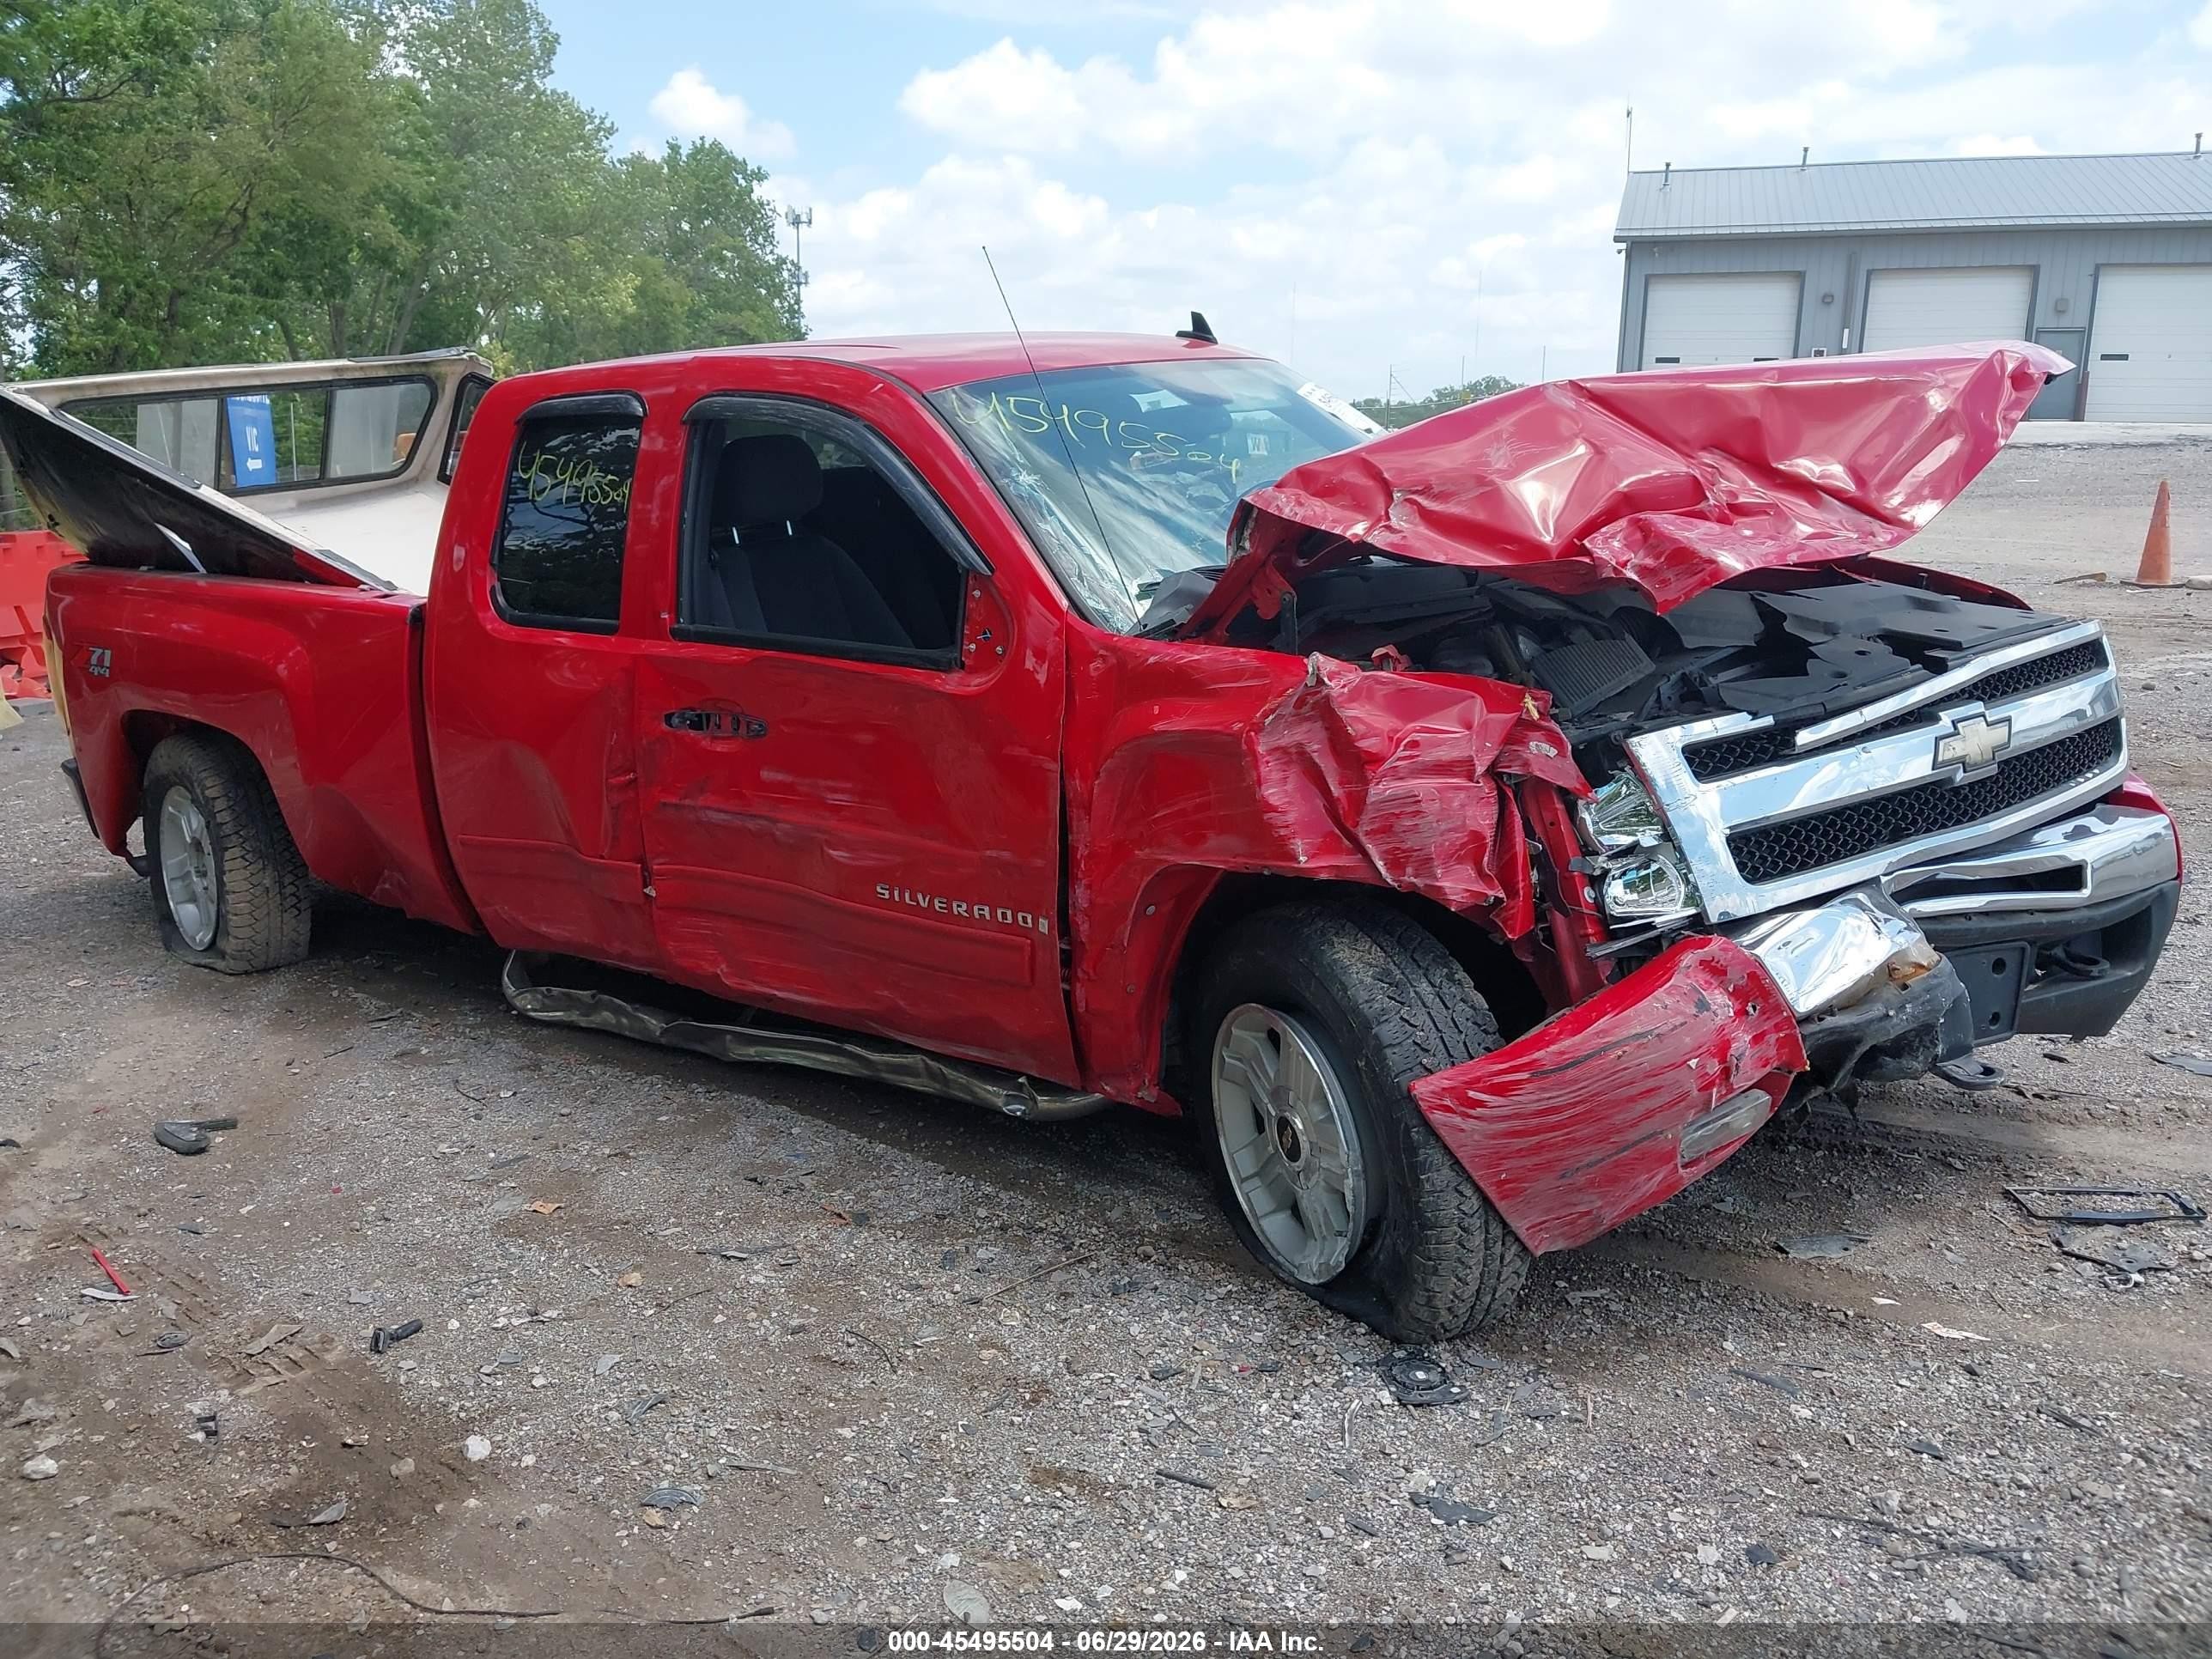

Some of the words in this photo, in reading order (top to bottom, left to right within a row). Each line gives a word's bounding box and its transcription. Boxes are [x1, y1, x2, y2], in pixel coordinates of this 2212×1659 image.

[245, 426, 259, 453] VIC
[951, 392, 1242, 484] 45495504
[518, 441, 633, 514] 45495504
[875, 883, 1034, 929] SILVERADO
